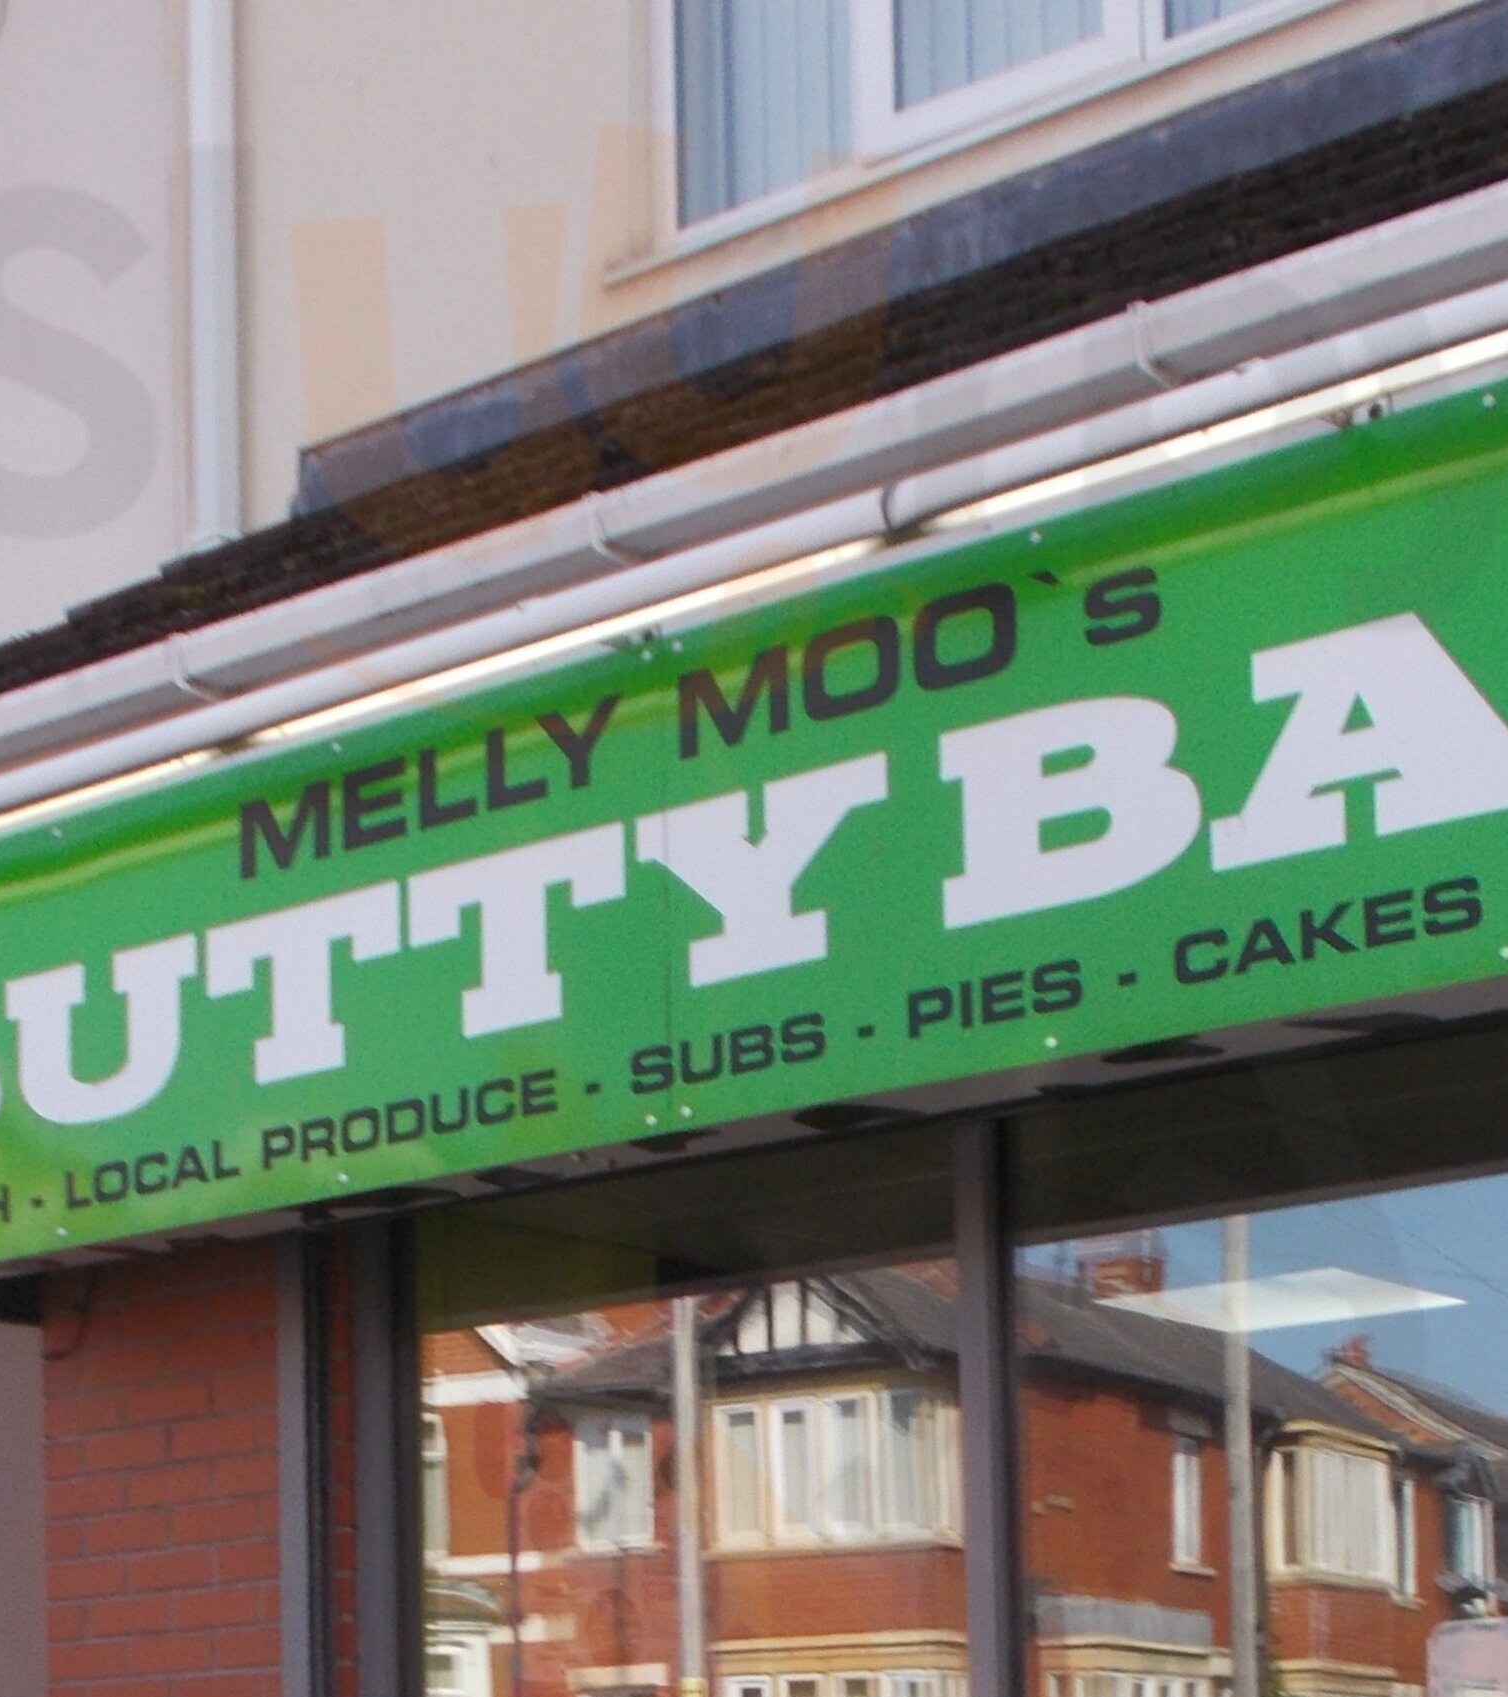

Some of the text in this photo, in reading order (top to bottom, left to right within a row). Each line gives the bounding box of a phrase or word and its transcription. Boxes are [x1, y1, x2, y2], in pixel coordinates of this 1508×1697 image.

[237, 692, 622, 881] MELLY
[64, 1140, 241, 1211] LOCAL
[261, 1067, 558, 1172] PRODUCE
[629, 1012, 828, 1097] SUBS
[906, 960, 1084, 1041] PIES
[1172, 876, 1483, 987] CAKES
